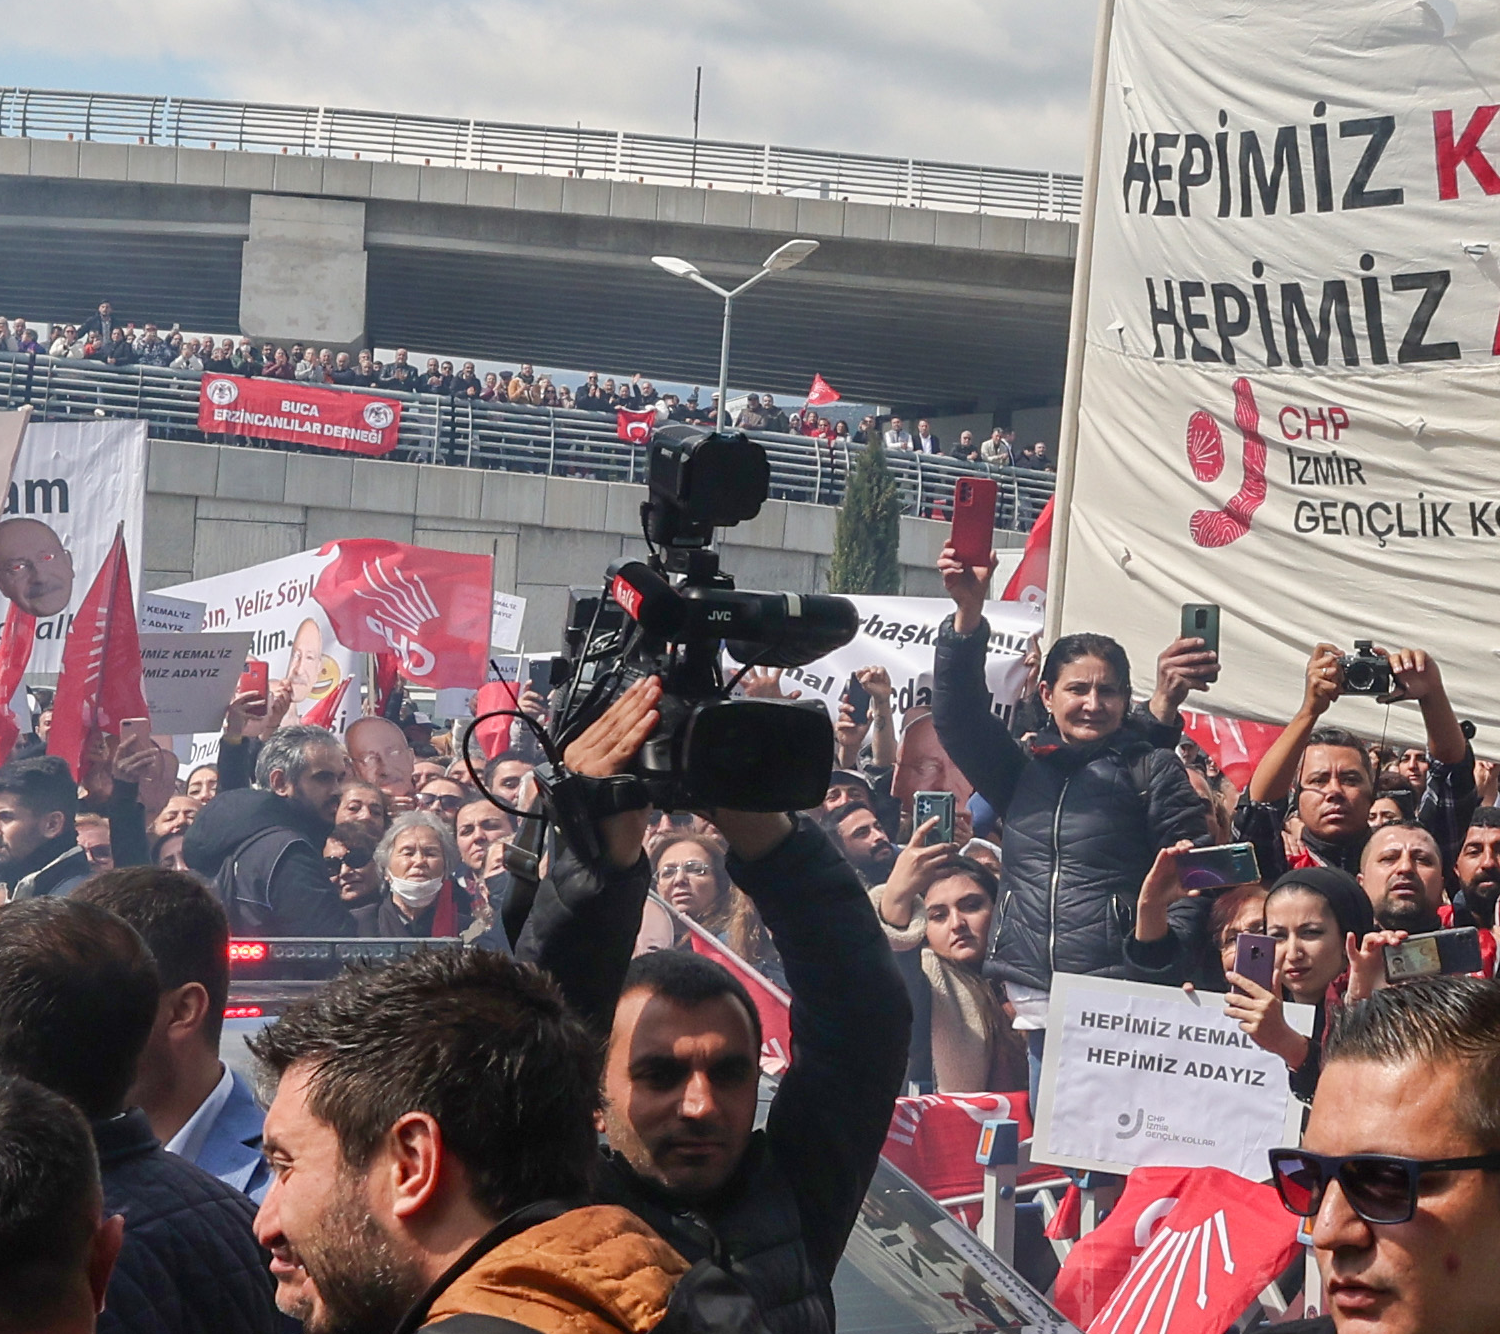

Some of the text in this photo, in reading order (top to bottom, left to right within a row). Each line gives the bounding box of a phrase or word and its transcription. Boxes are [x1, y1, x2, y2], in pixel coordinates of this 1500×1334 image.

[1122, 101, 1404, 218] HEPİMİZ
[1145, 253, 1461, 367] HEPİMİZ
[281, 400, 319, 417] BUCA
[1278, 406, 1350, 441] CHP
[214, 409, 382, 445] ERZİNCANLILAR DERNEĞİ
[1288, 447, 1366, 486] İZMİR
[1294, 492, 1456, 548] GENÇLİK
[235, 589, 273, 621] Yeliz
[276, 574, 315, 607] Söyl
[708, 610, 732, 622] JVC
[139, 647, 170, 660] İMİZ
[1080, 1011, 1171, 1038] HEPİMİZ
[1087, 1047, 1266, 1087] HEPİMİZ ADAYIZ
[1147, 1114, 1165, 1122] CHP
